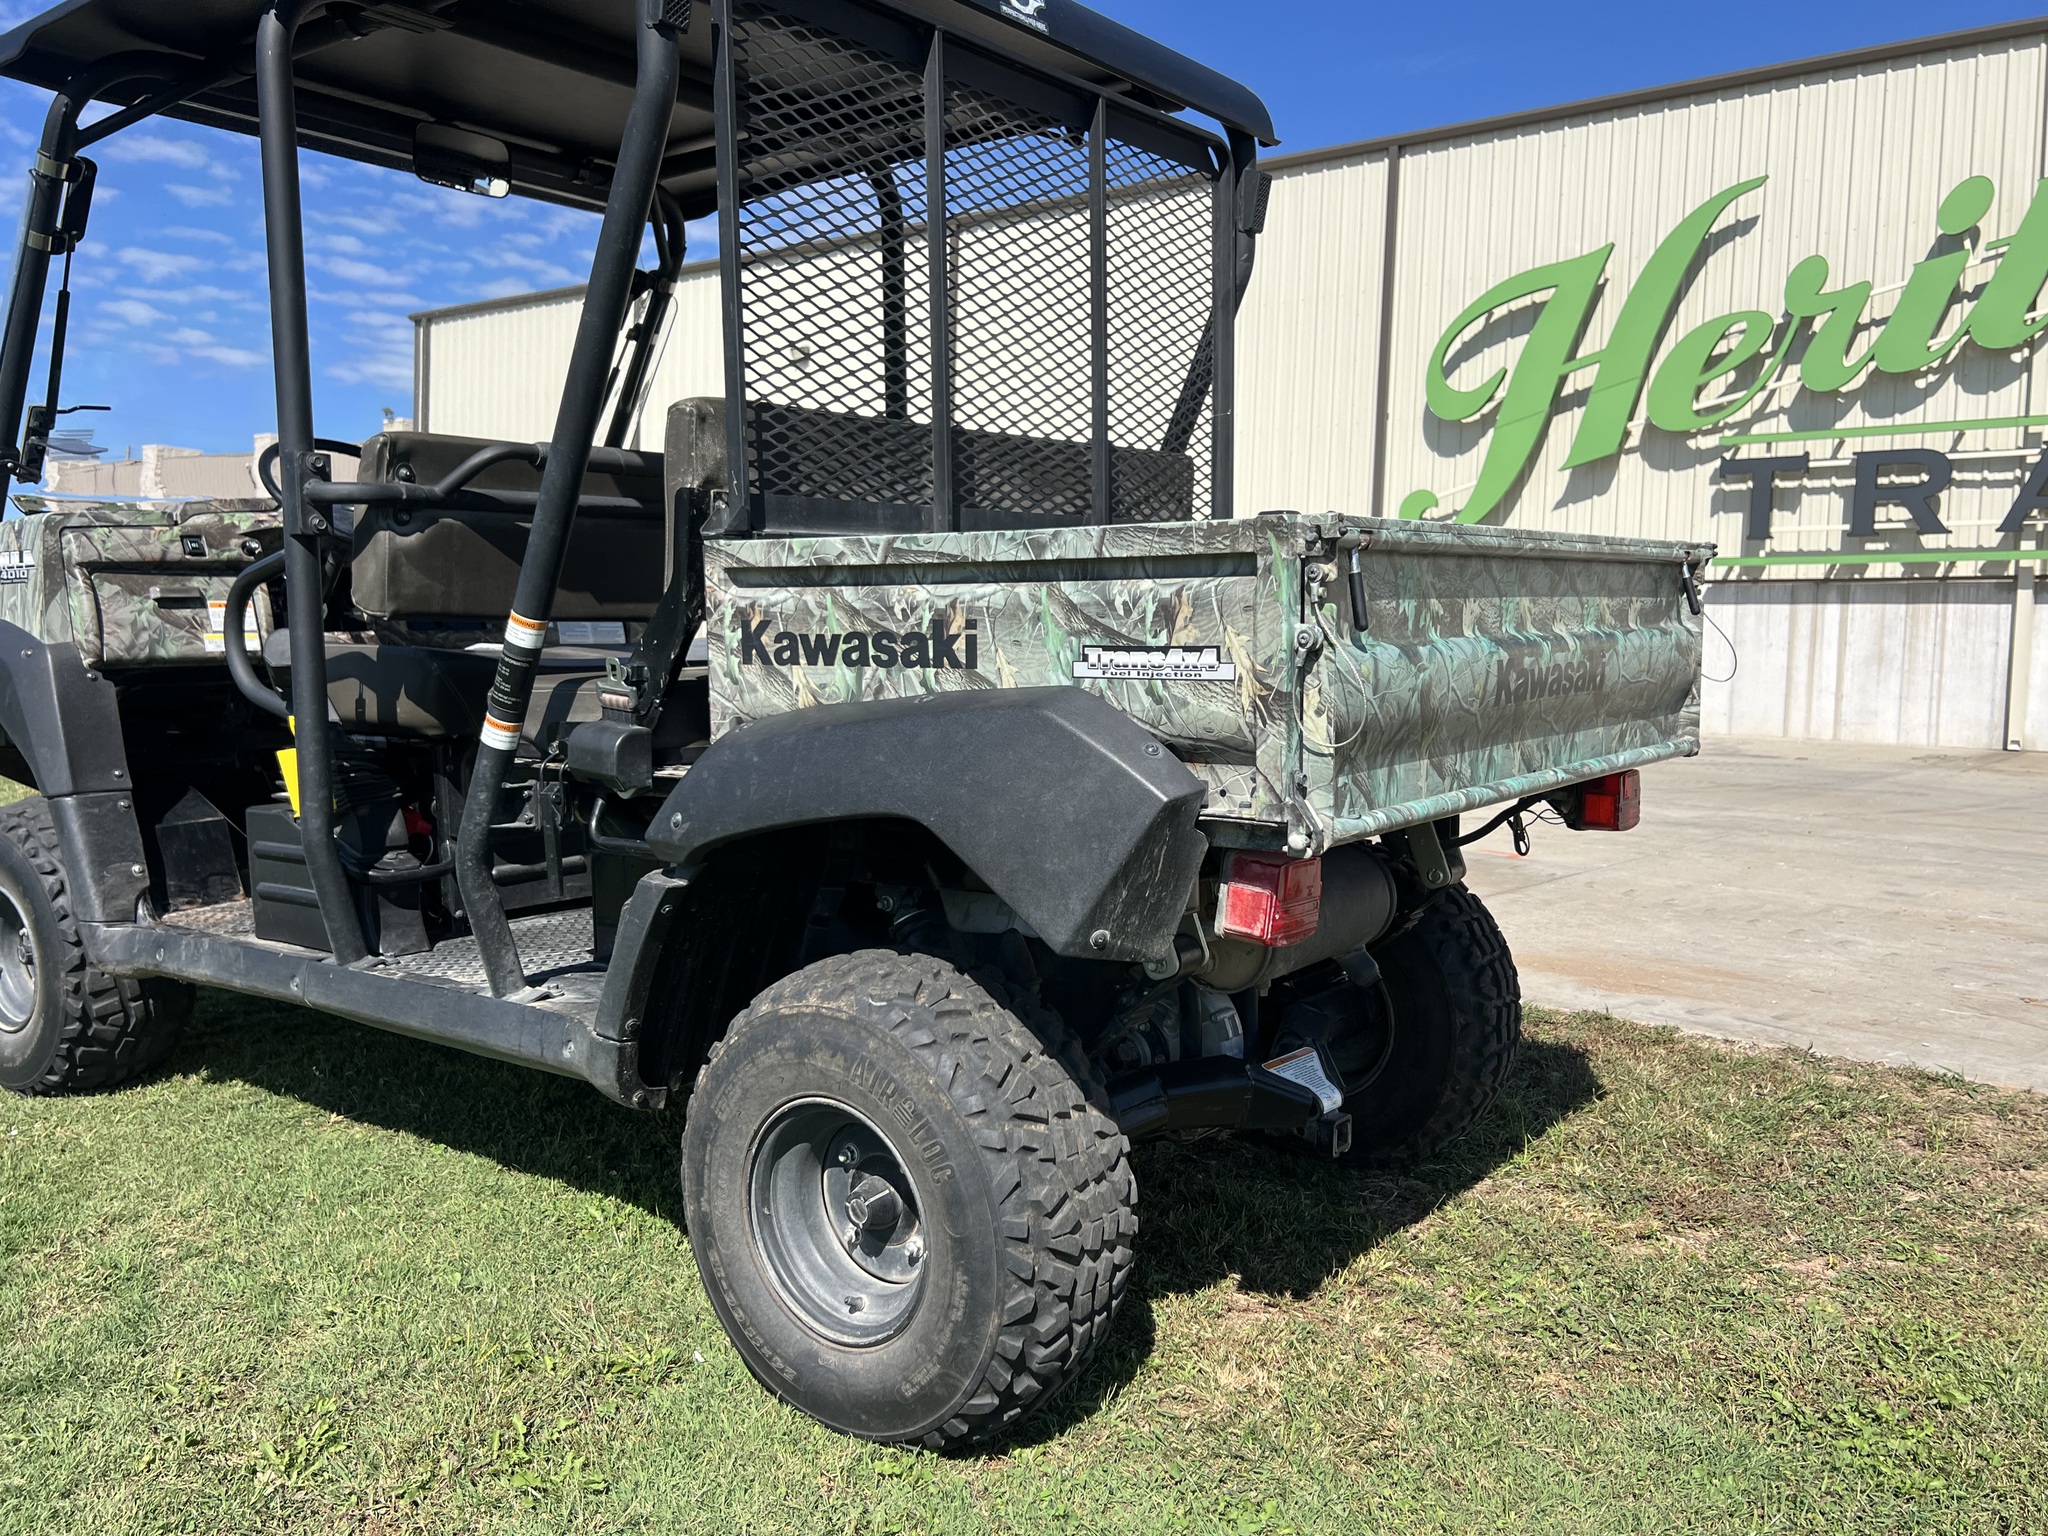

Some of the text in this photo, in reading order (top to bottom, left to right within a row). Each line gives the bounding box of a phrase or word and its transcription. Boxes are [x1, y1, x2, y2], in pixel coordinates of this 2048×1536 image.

[1, 570, 28, 579] 4010
[741, 618, 978, 670] Kawasaki
[1084, 647, 1220, 671] Trans4x4
[1136, 671, 1203, 679] Injection
[1494, 649, 1606, 707] Kawasaki
